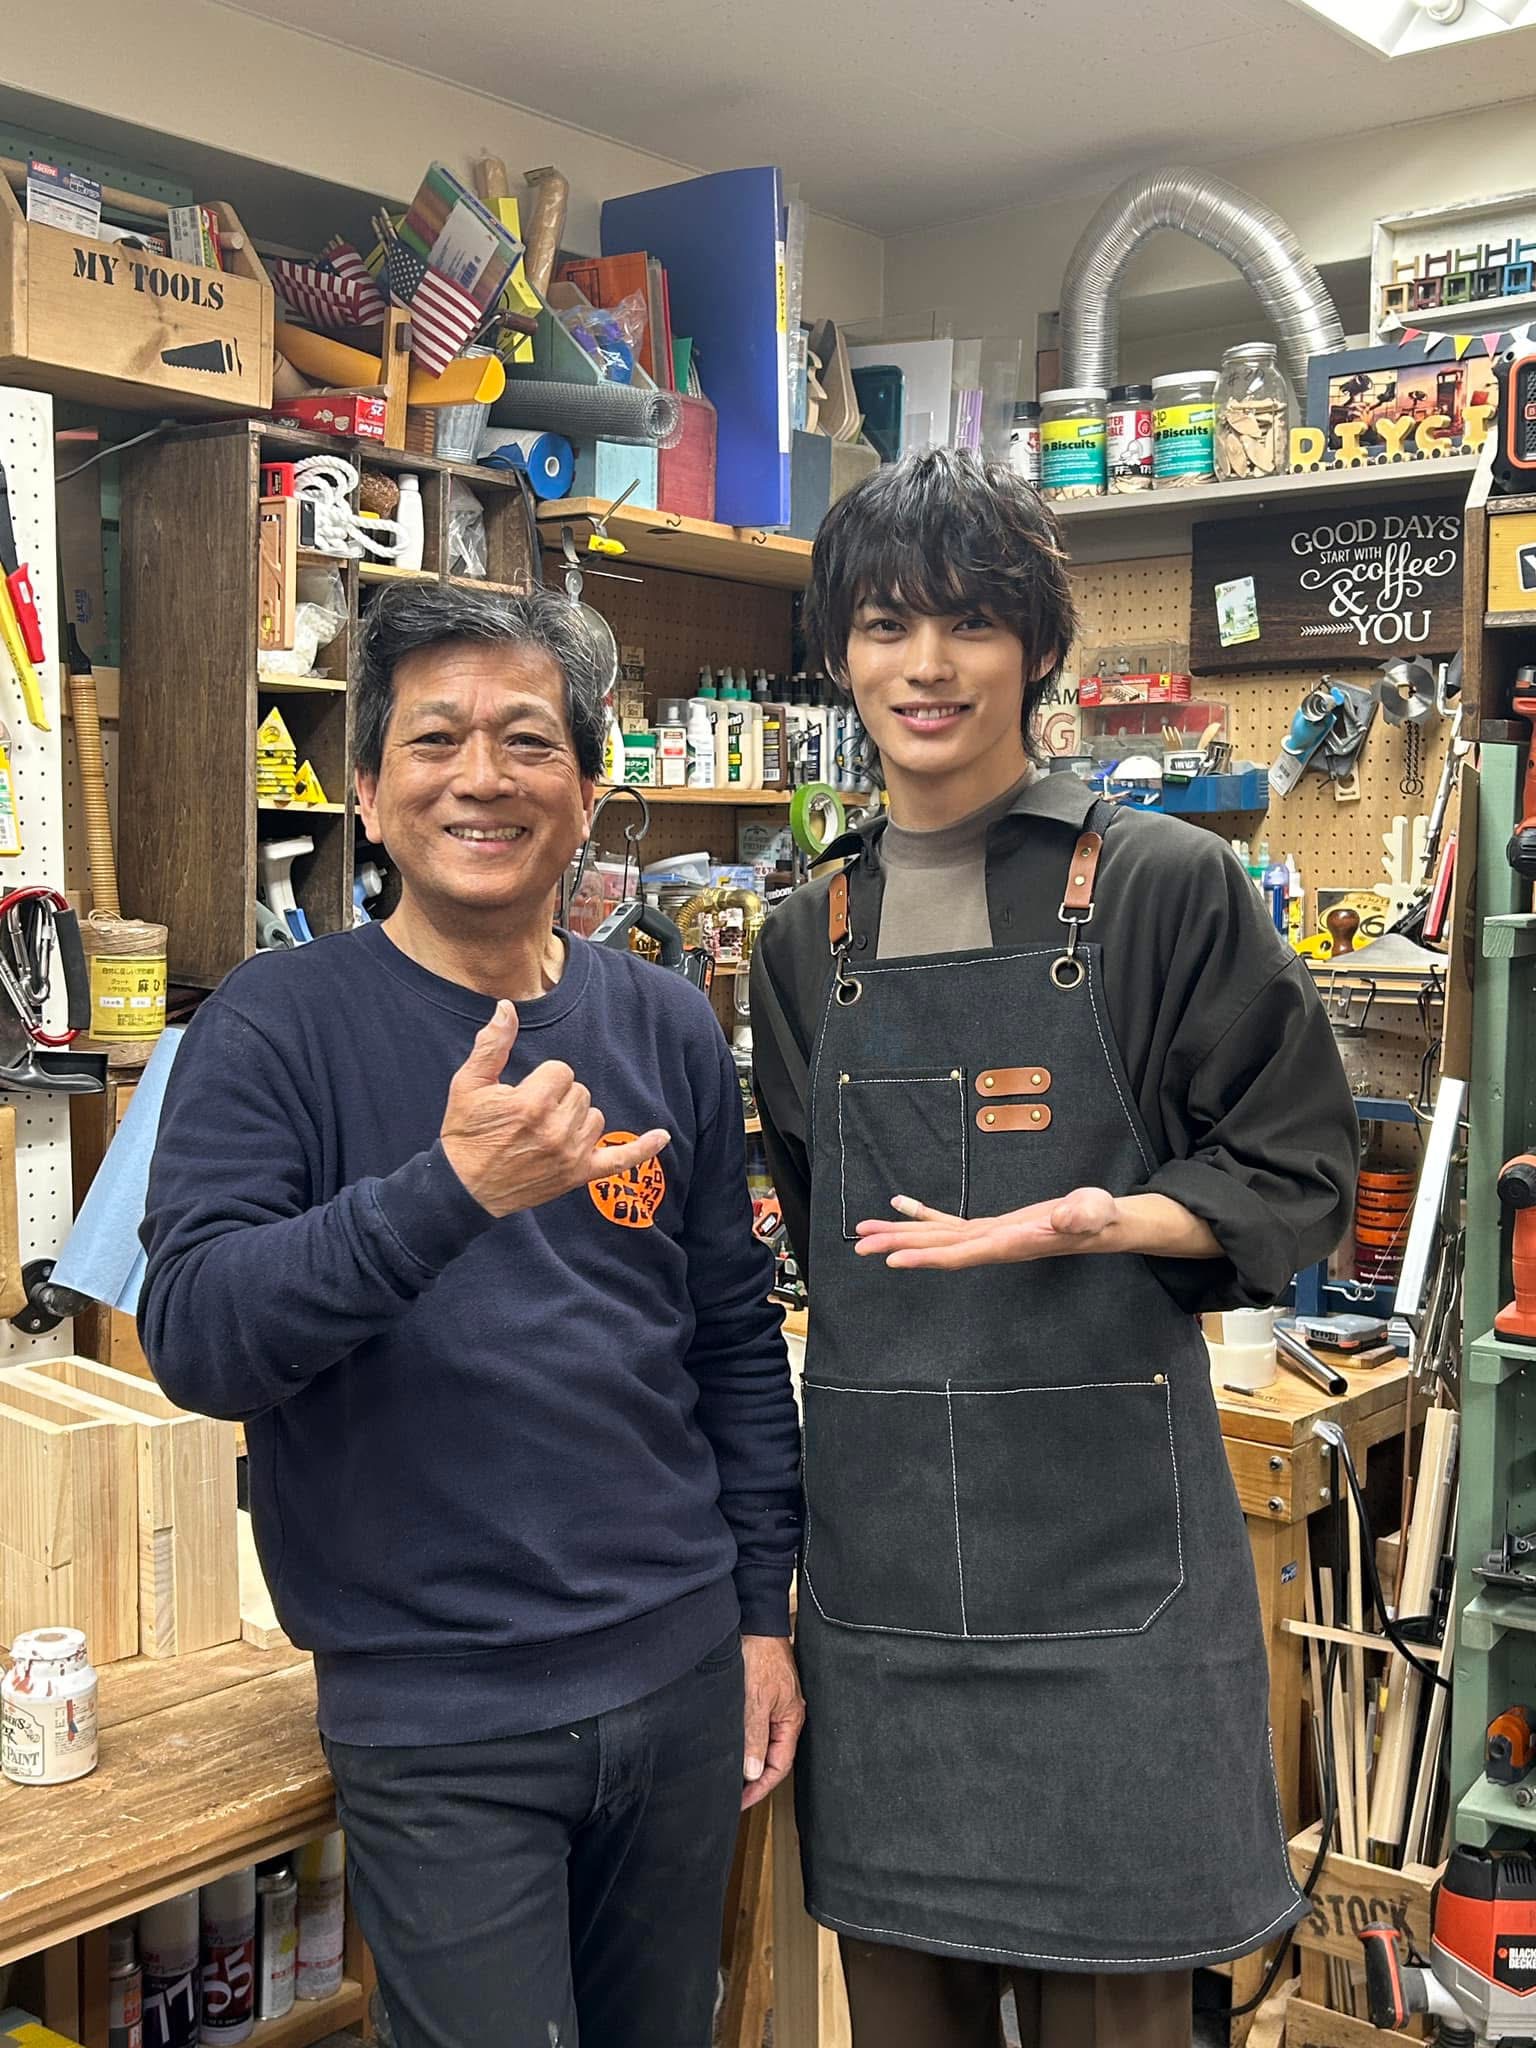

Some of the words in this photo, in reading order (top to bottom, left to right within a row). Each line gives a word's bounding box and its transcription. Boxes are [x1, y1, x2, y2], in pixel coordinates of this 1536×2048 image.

[73, 248, 118, 285] MY
[129, 262, 223, 310] TOOLS
[1051, 440, 1096, 451] Biscuits
[1163, 427, 1208, 439] Biscuits
[1291, 519, 1376, 555] GOOD
[1383, 515, 1461, 541] DAYS
[1320, 549, 1350, 564] START
[1353, 546, 1382, 561] WITH
[1300, 541, 1456, 612] coffee
[1329, 578, 1368, 617] &
[1350, 610, 1431, 646] YOU
[7, 1746, 40, 1766] PAINT
[1307, 1892, 1414, 1941] STOCK
[202, 1945, 252, 2013] 55
[143, 1972, 195, 2045] 77
